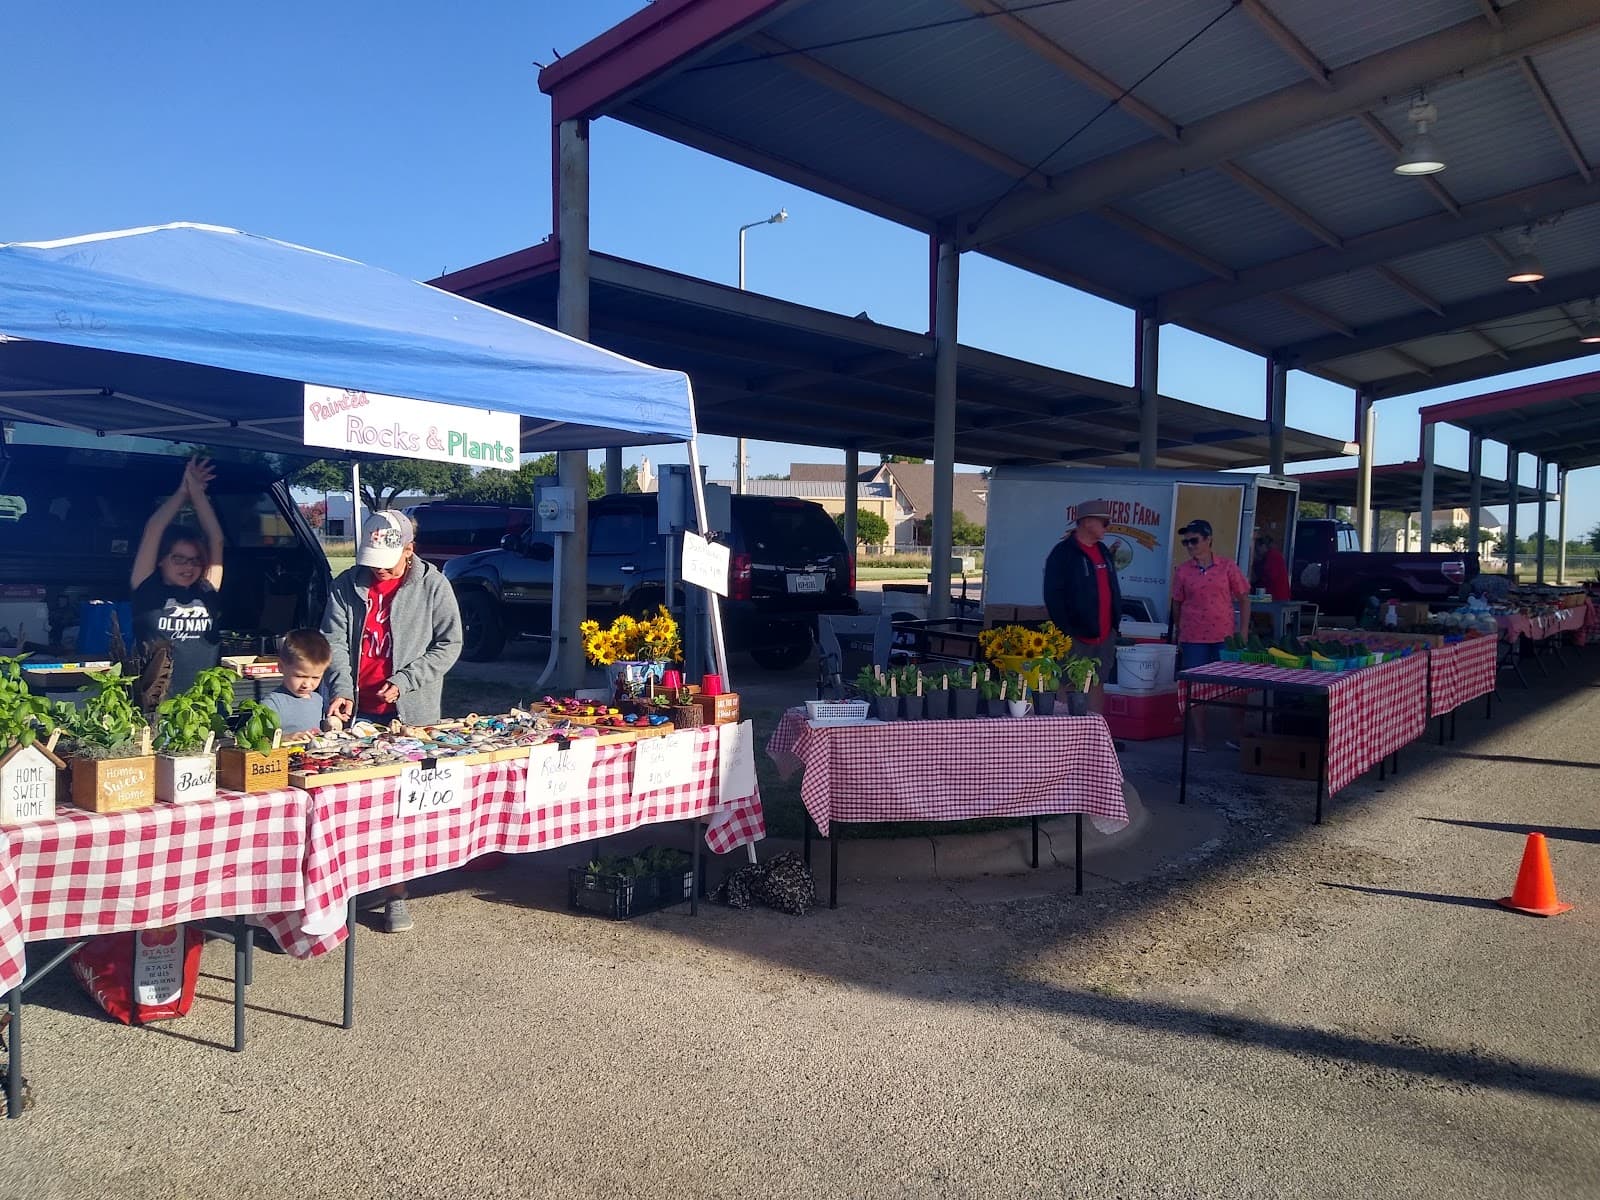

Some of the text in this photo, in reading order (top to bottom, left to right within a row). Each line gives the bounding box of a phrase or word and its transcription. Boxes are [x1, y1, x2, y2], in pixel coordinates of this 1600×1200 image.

[309, 391, 370, 422] Painted
[346, 414, 514, 464] Rocks & Plants
[1133, 501, 1161, 527] FARM
[158, 616, 214, 632] OLD NAVY
[16, 767, 44, 783] HOME
[106, 766, 135, 780] Home
[252, 760, 282, 776] Basil
[410, 768, 452, 785] Rocks
[103, 769, 147, 797] Sweet
[176, 770, 215, 792] Basil
[12, 784, 49, 801] SWEET
[118, 789, 145, 803] Home
[408, 789, 454, 811] $1.00
[16, 801, 44, 818] HOME
